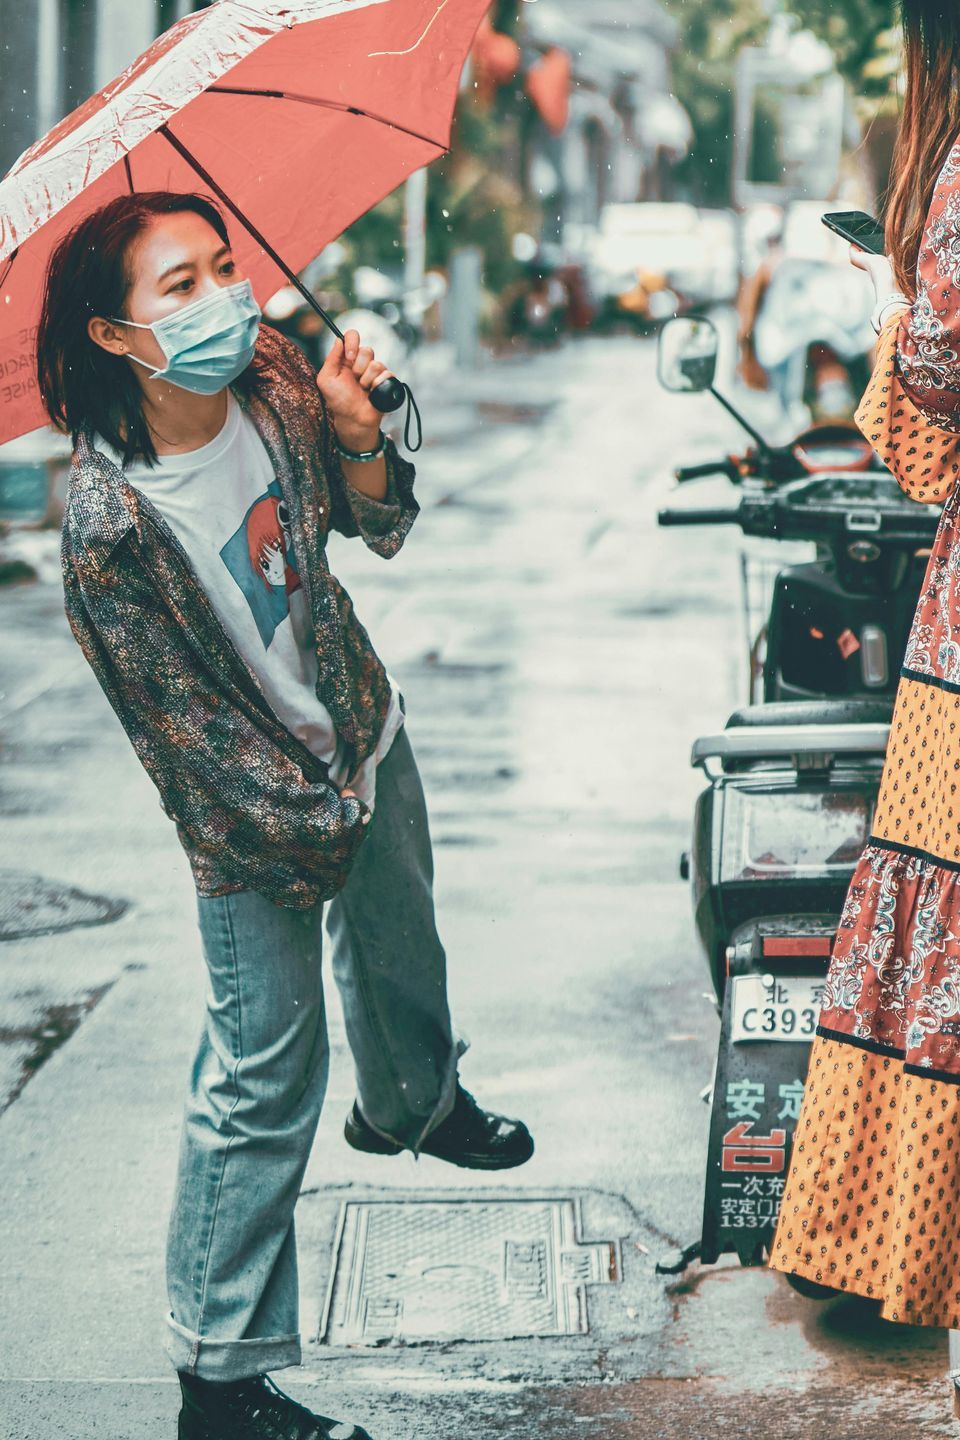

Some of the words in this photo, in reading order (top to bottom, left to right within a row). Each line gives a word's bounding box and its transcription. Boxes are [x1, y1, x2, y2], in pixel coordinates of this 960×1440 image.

[742, 1008, 816, 1034] C393
[722, 1121, 787, 1173] 台
[721, 1175, 786, 1197] 一次充
